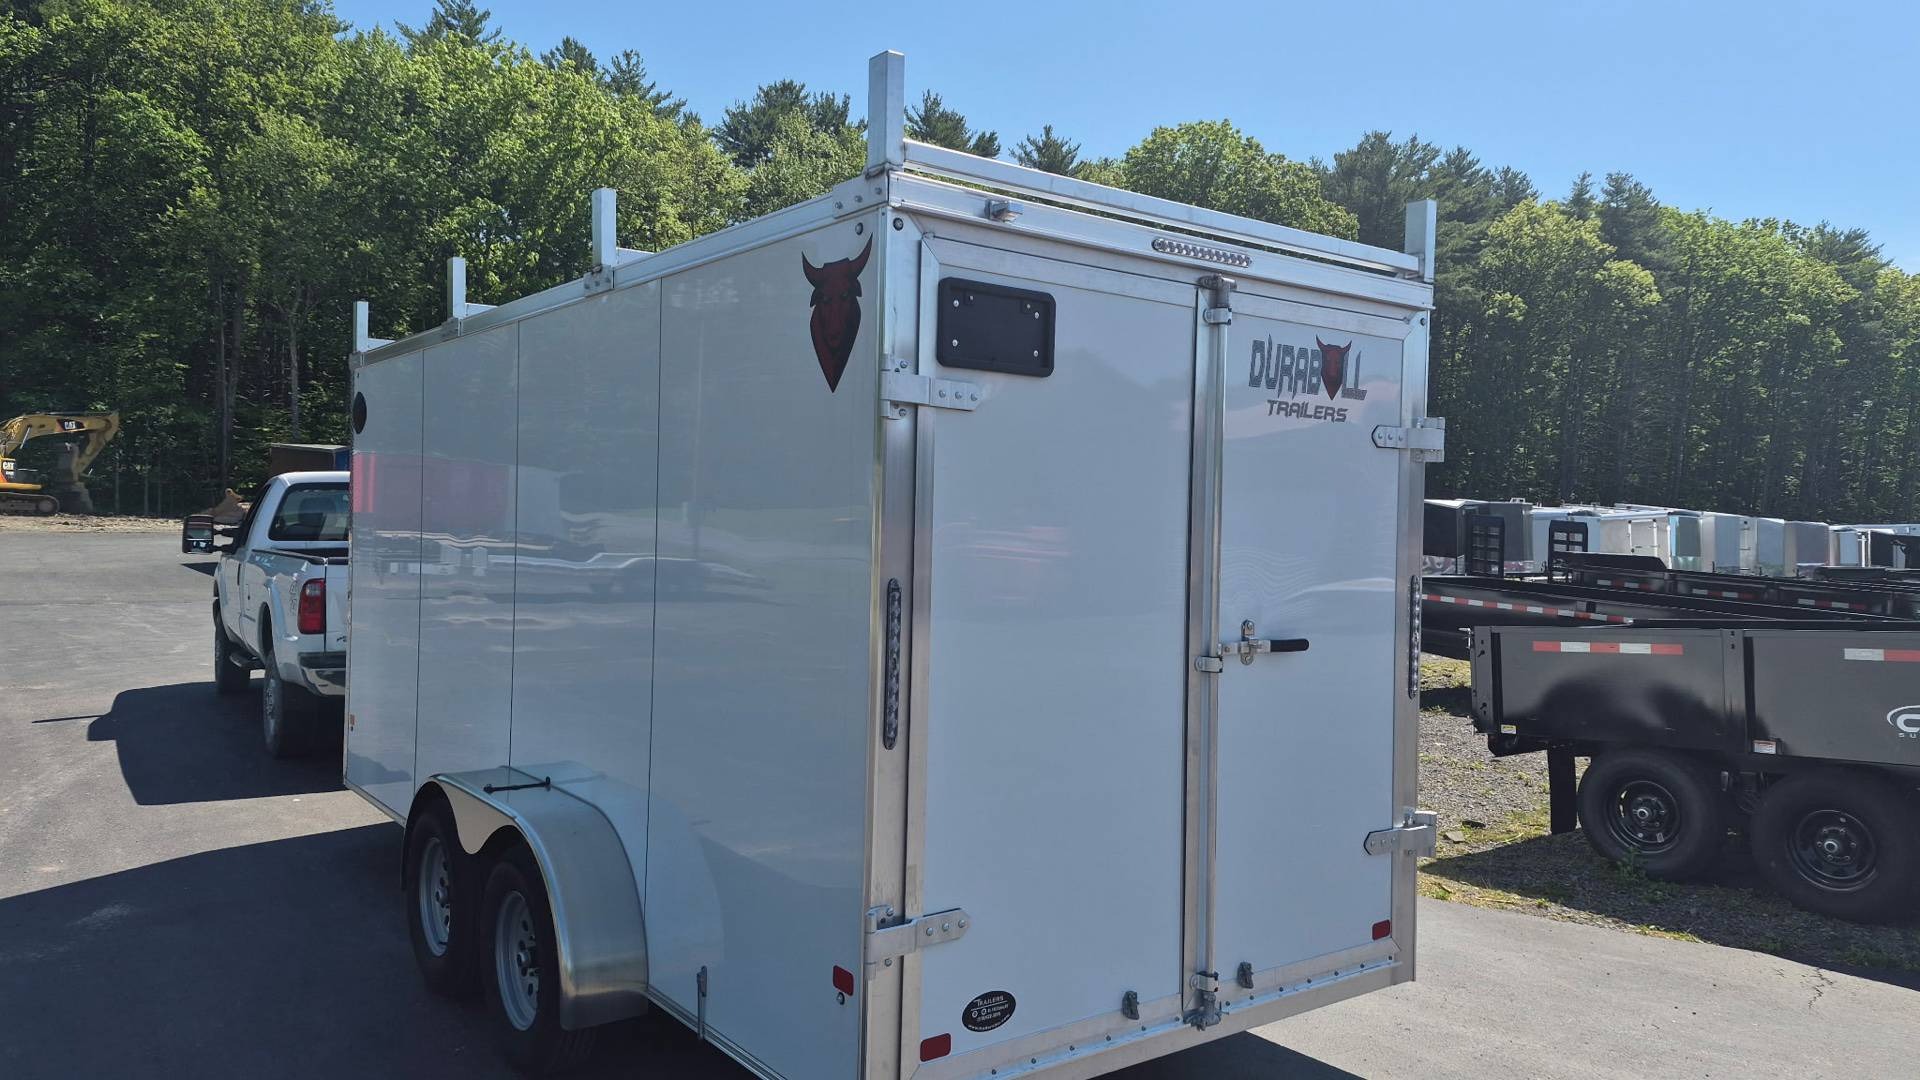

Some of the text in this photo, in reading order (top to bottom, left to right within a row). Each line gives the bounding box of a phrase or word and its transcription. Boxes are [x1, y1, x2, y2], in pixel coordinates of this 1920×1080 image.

[1267, 399, 1348, 423] TRAILERS
[64, 421, 76, 429] CAT
[2, 461, 15, 470] CAT
